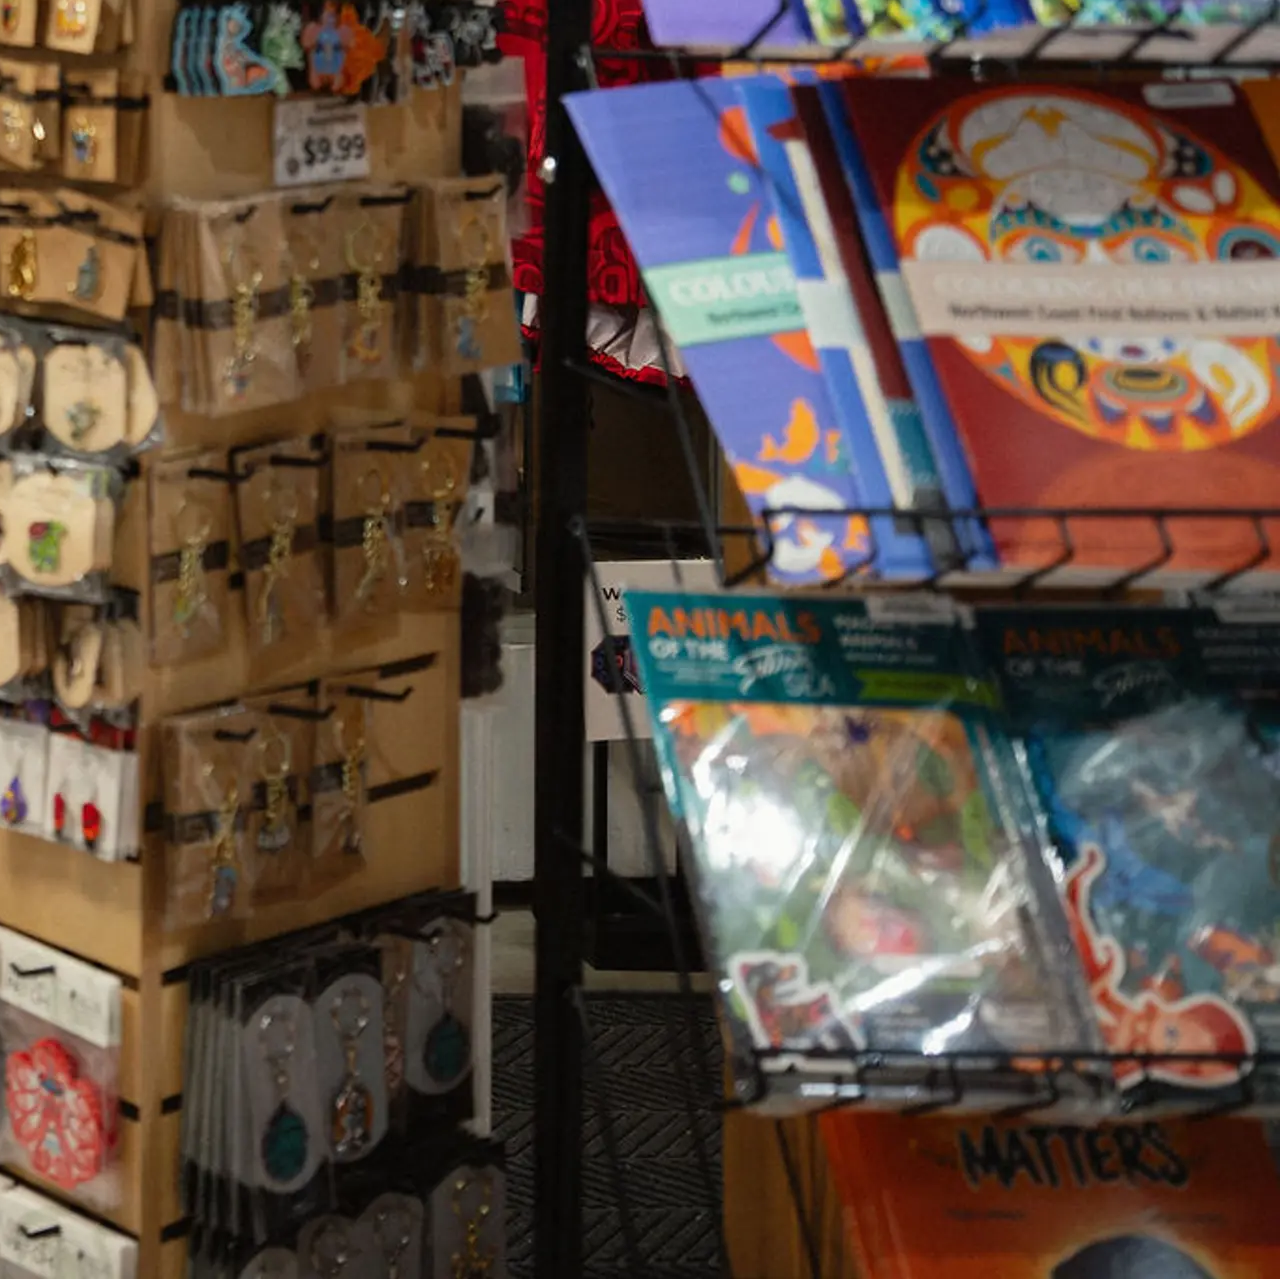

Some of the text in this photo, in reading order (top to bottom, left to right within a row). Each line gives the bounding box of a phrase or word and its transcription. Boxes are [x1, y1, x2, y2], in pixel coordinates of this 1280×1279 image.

[303, 133, 366, 167] $9.99
[648, 606, 822, 643] ANIMALS
[648, 640, 729, 662] OF THE
[1003, 627, 1182, 657] ANIMALS
[957, 1121, 1189, 1192] MATTERS
